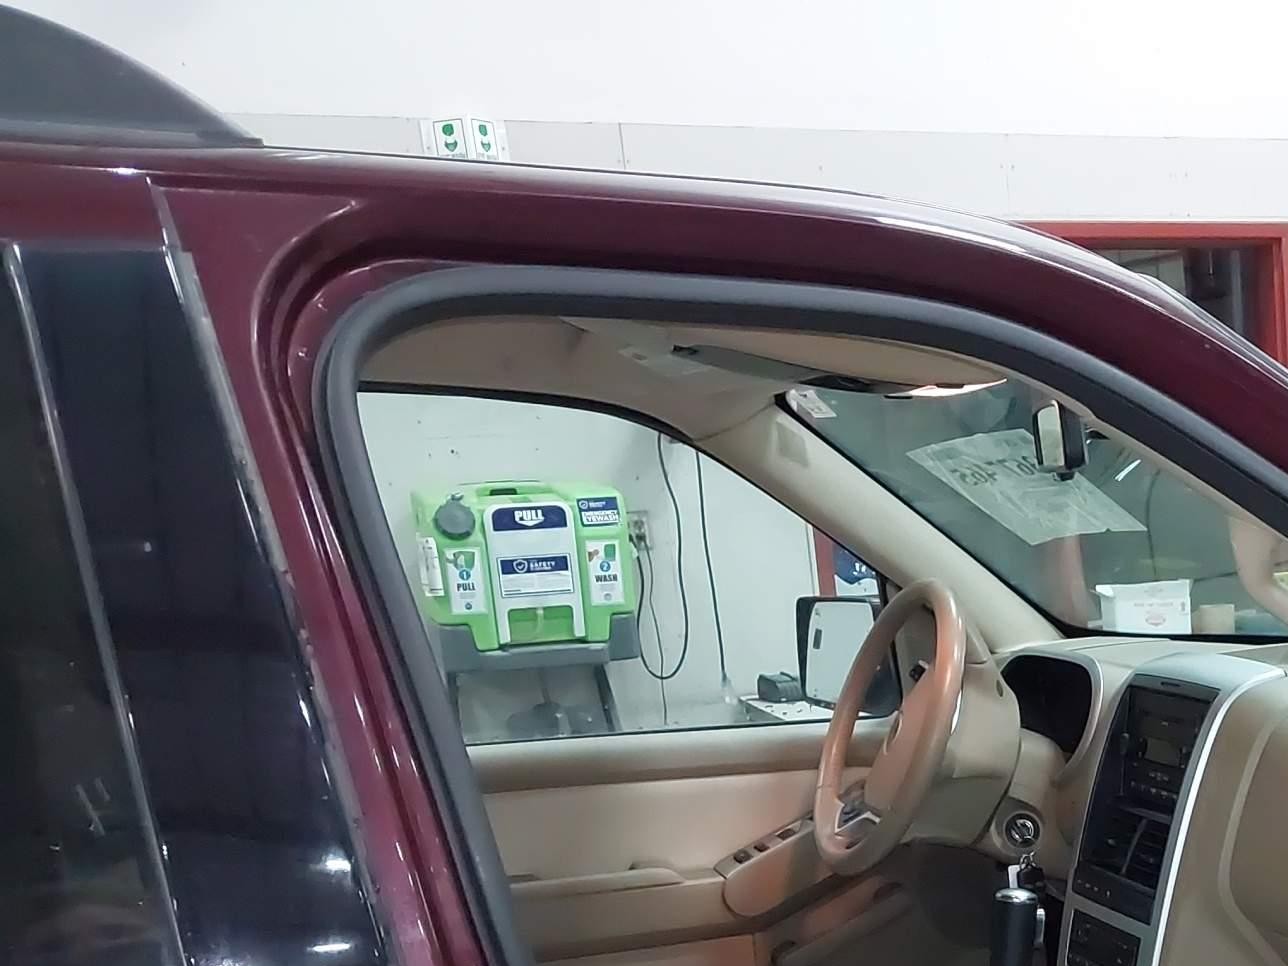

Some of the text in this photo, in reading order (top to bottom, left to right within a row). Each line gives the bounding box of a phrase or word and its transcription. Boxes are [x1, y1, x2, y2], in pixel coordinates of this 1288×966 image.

[514, 509, 545, 522] PULL
[594, 573, 618, 583] WASH
[456, 582, 476, 592] PULL
